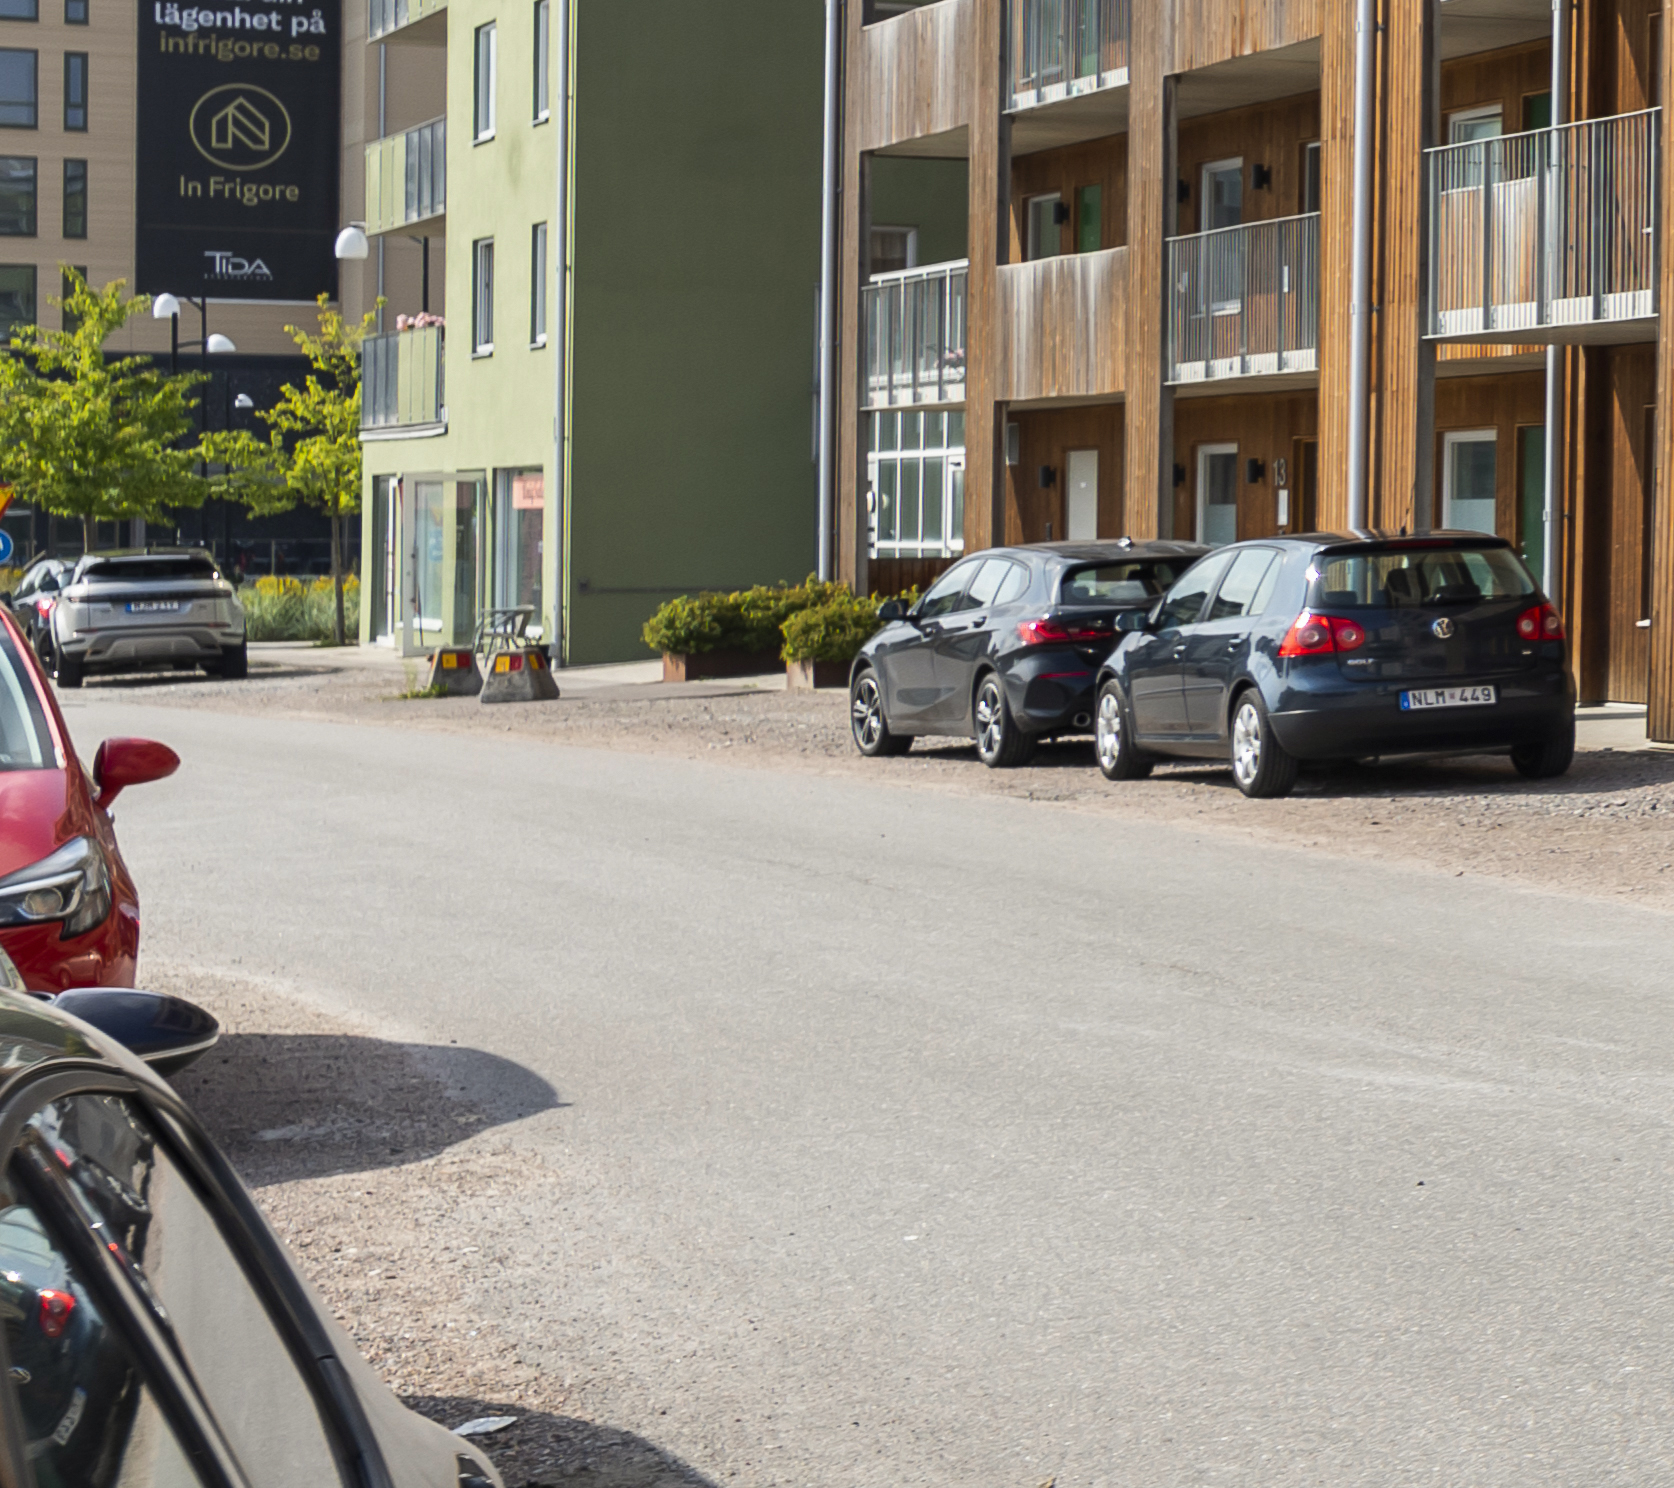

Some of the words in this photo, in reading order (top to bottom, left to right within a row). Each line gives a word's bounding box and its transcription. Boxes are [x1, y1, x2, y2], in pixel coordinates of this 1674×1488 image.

[155, 1, 282, 31] lägenhet
[291, 9, 326, 38] på
[160, 30, 320, 62] infrigore.se
[180, 175, 201, 197] In
[210, 176, 299, 206] Frigore
[1273, 458, 1286, 486] 13
[1411, 690, 1447, 706] NLM
[1459, 687, 1492, 702] 449
